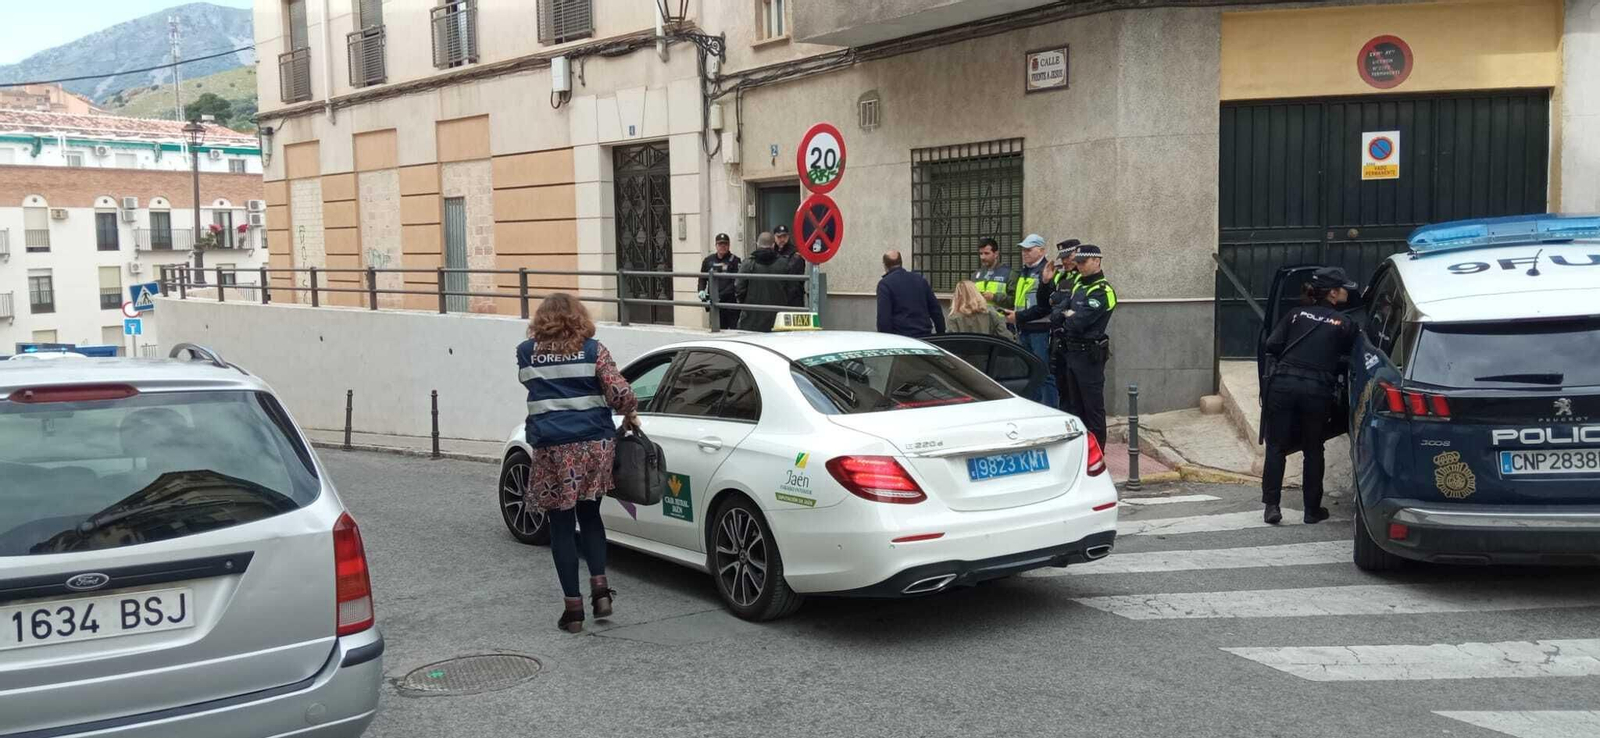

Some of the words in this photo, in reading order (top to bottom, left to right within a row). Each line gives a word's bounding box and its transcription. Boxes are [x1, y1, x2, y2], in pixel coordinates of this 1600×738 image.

[1040, 56, 1060, 67] CALLE
[1047, 71, 1050, 79] A
[810, 147, 837, 170] 20
[793, 314, 811, 326] TAXI
[531, 351, 585, 364] FORENSE
[978, 456, 1016, 476] 9823
[1019, 450, 1045, 470] KMT
[785, 470, 810, 487] Jaén
[76, 576, 99, 586] Ford
[12, 603, 100, 643] 1634
[121, 593, 186, 630] BSJ
